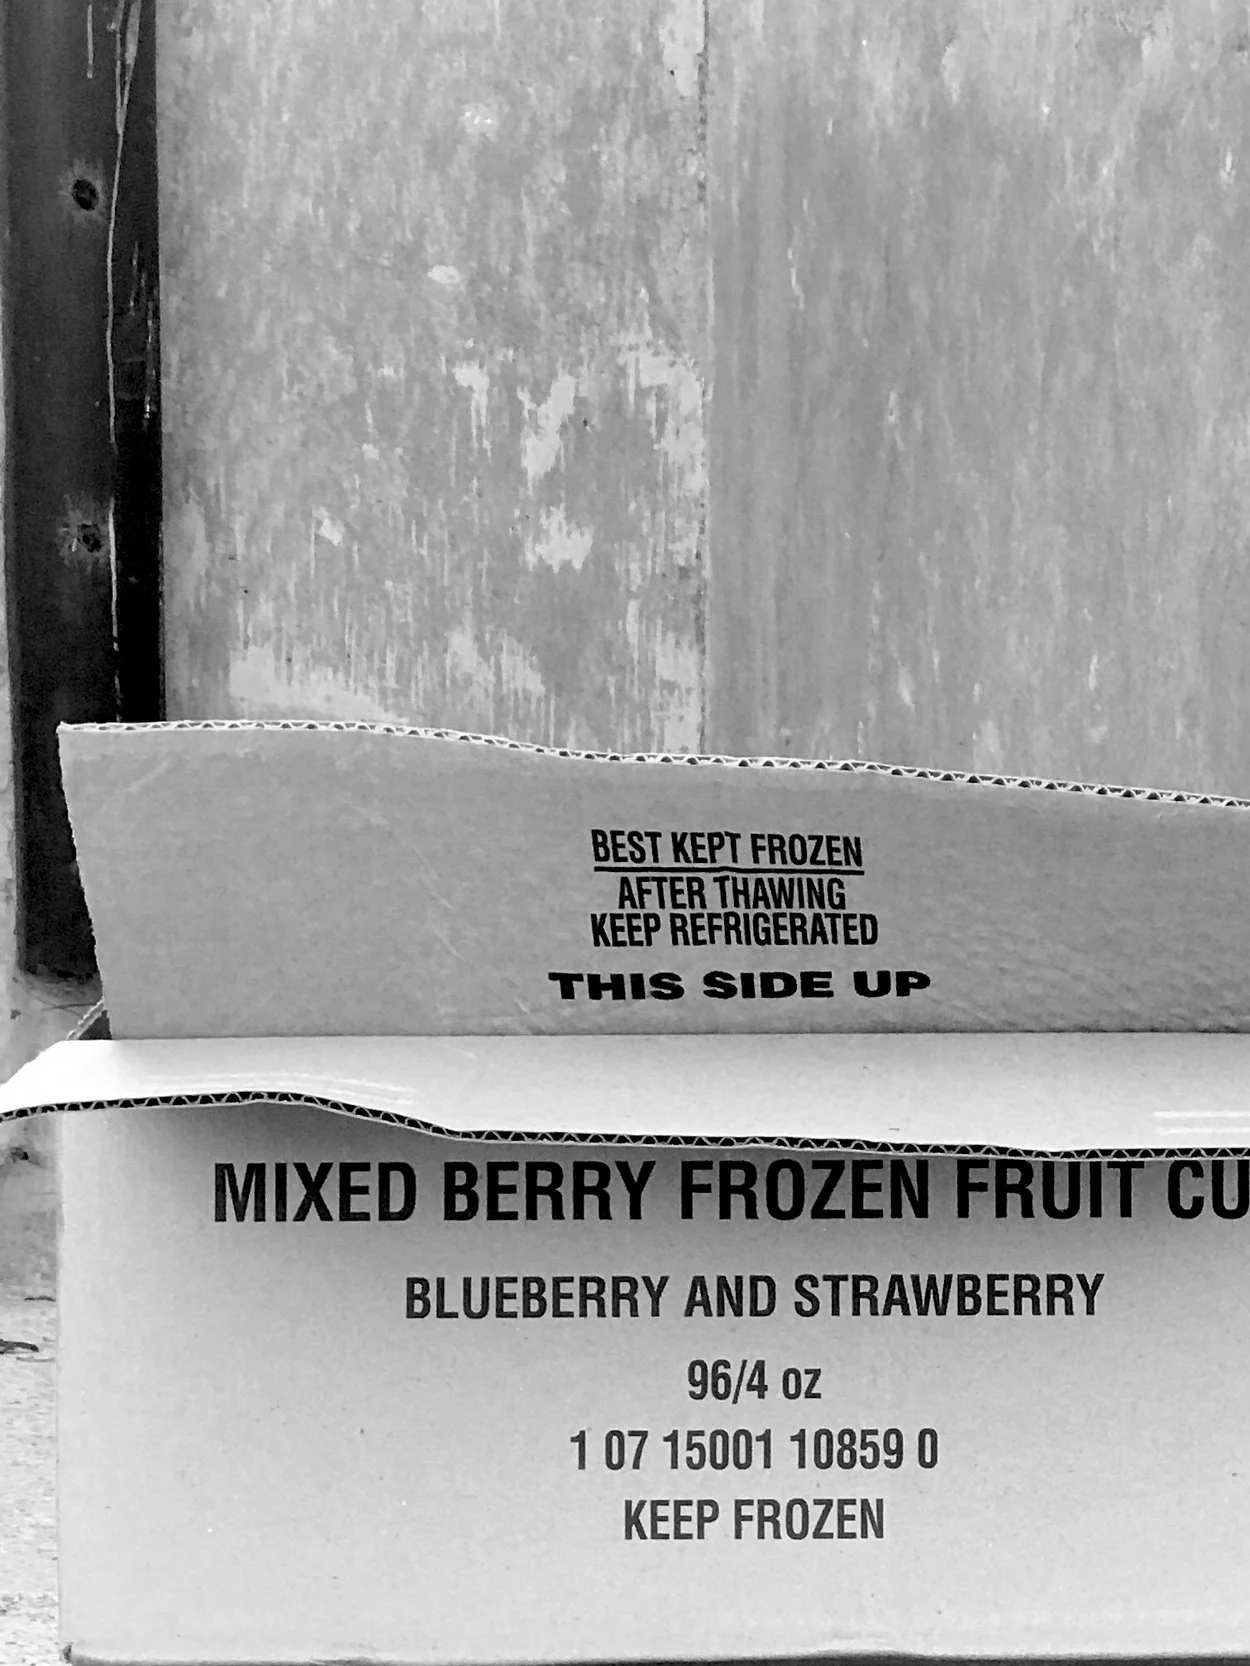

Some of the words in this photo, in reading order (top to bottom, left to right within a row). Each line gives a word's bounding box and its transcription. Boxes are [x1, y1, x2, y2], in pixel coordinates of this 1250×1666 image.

[591, 829, 662, 864] BEST
[671, 831, 741, 864] KEPT
[750, 833, 864, 867] FROZEN
[618, 876, 706, 910] AFTER
[713, 875, 846, 910] THAWING
[590, 912, 661, 948] KEEP
[670, 911, 879, 947] REFRIGERATED
[548, 971, 685, 1001] THIS
[702, 970, 835, 999] SIDE
[853, 970, 931, 998] UP
[213, 1161, 417, 1223] MIXED
[443, 1160, 657, 1222] BERRY
[680, 1158, 930, 1221] FROZEN
[956, 1158, 1145, 1220] FRUIT
[405, 1276, 670, 1319] BLUEBERRY
[684, 1275, 776, 1318] AND
[794, 1273, 1105, 1317] STRAWBERRY
[687, 1359, 768, 1404] 96/4
[782, 1368, 822, 1400] oz
[570, 1430, 587, 1470] 1
[604, 1429, 649, 1470] 07
[663, 1429, 773, 1470] 15001
[789, 1428, 903, 1470] 10859
[917, 1428, 939, 1470] 0
[624, 1499, 720, 1540] KEEP
[734, 1498, 885, 1540] FROZEN
